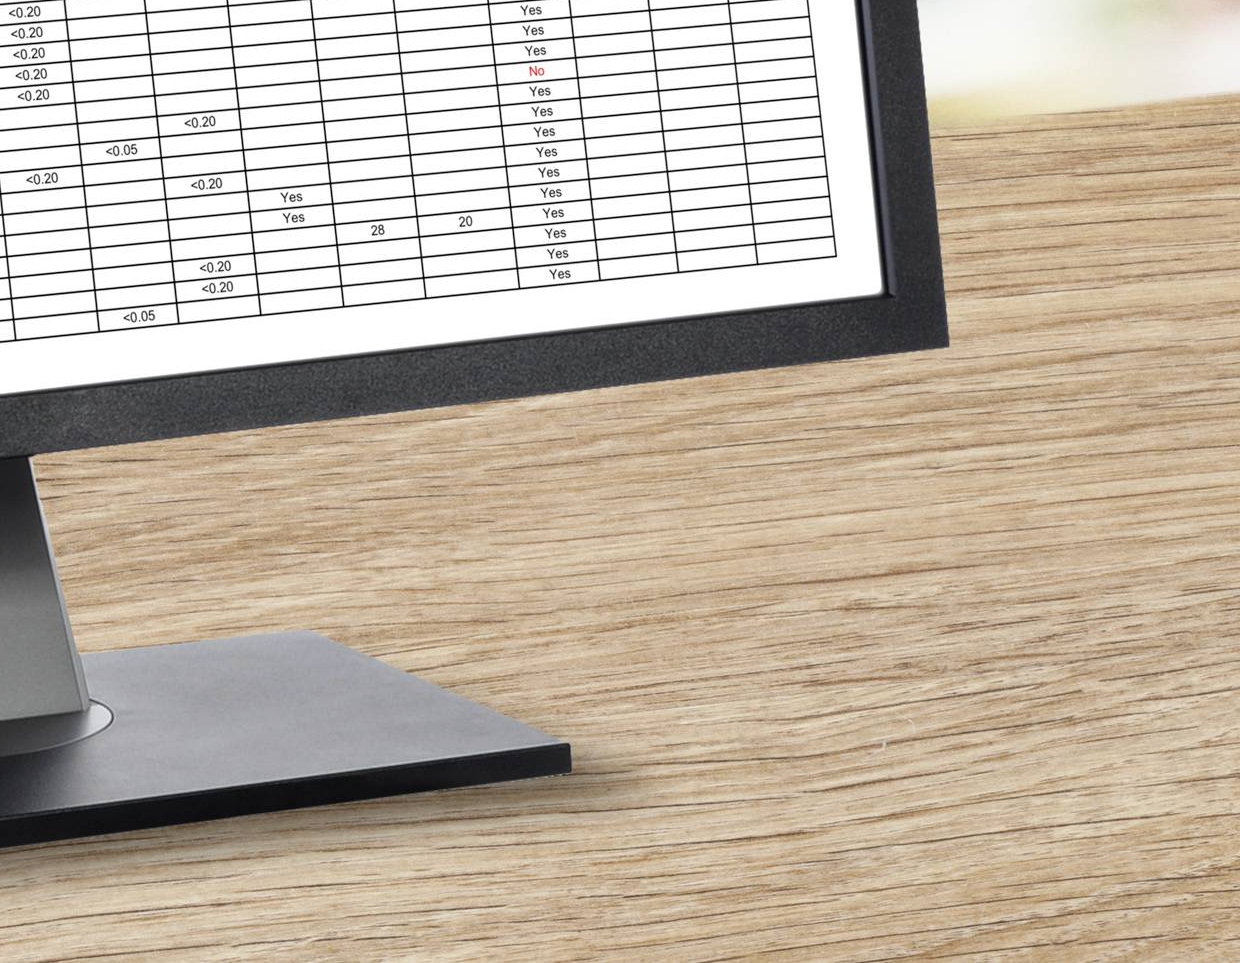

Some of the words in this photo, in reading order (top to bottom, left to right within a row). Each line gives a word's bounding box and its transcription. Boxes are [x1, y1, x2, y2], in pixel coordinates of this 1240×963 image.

[185, 116, 215, 128] <0.20
[459, 216, 472, 227] 20
[371, 225, 384, 235] 28
